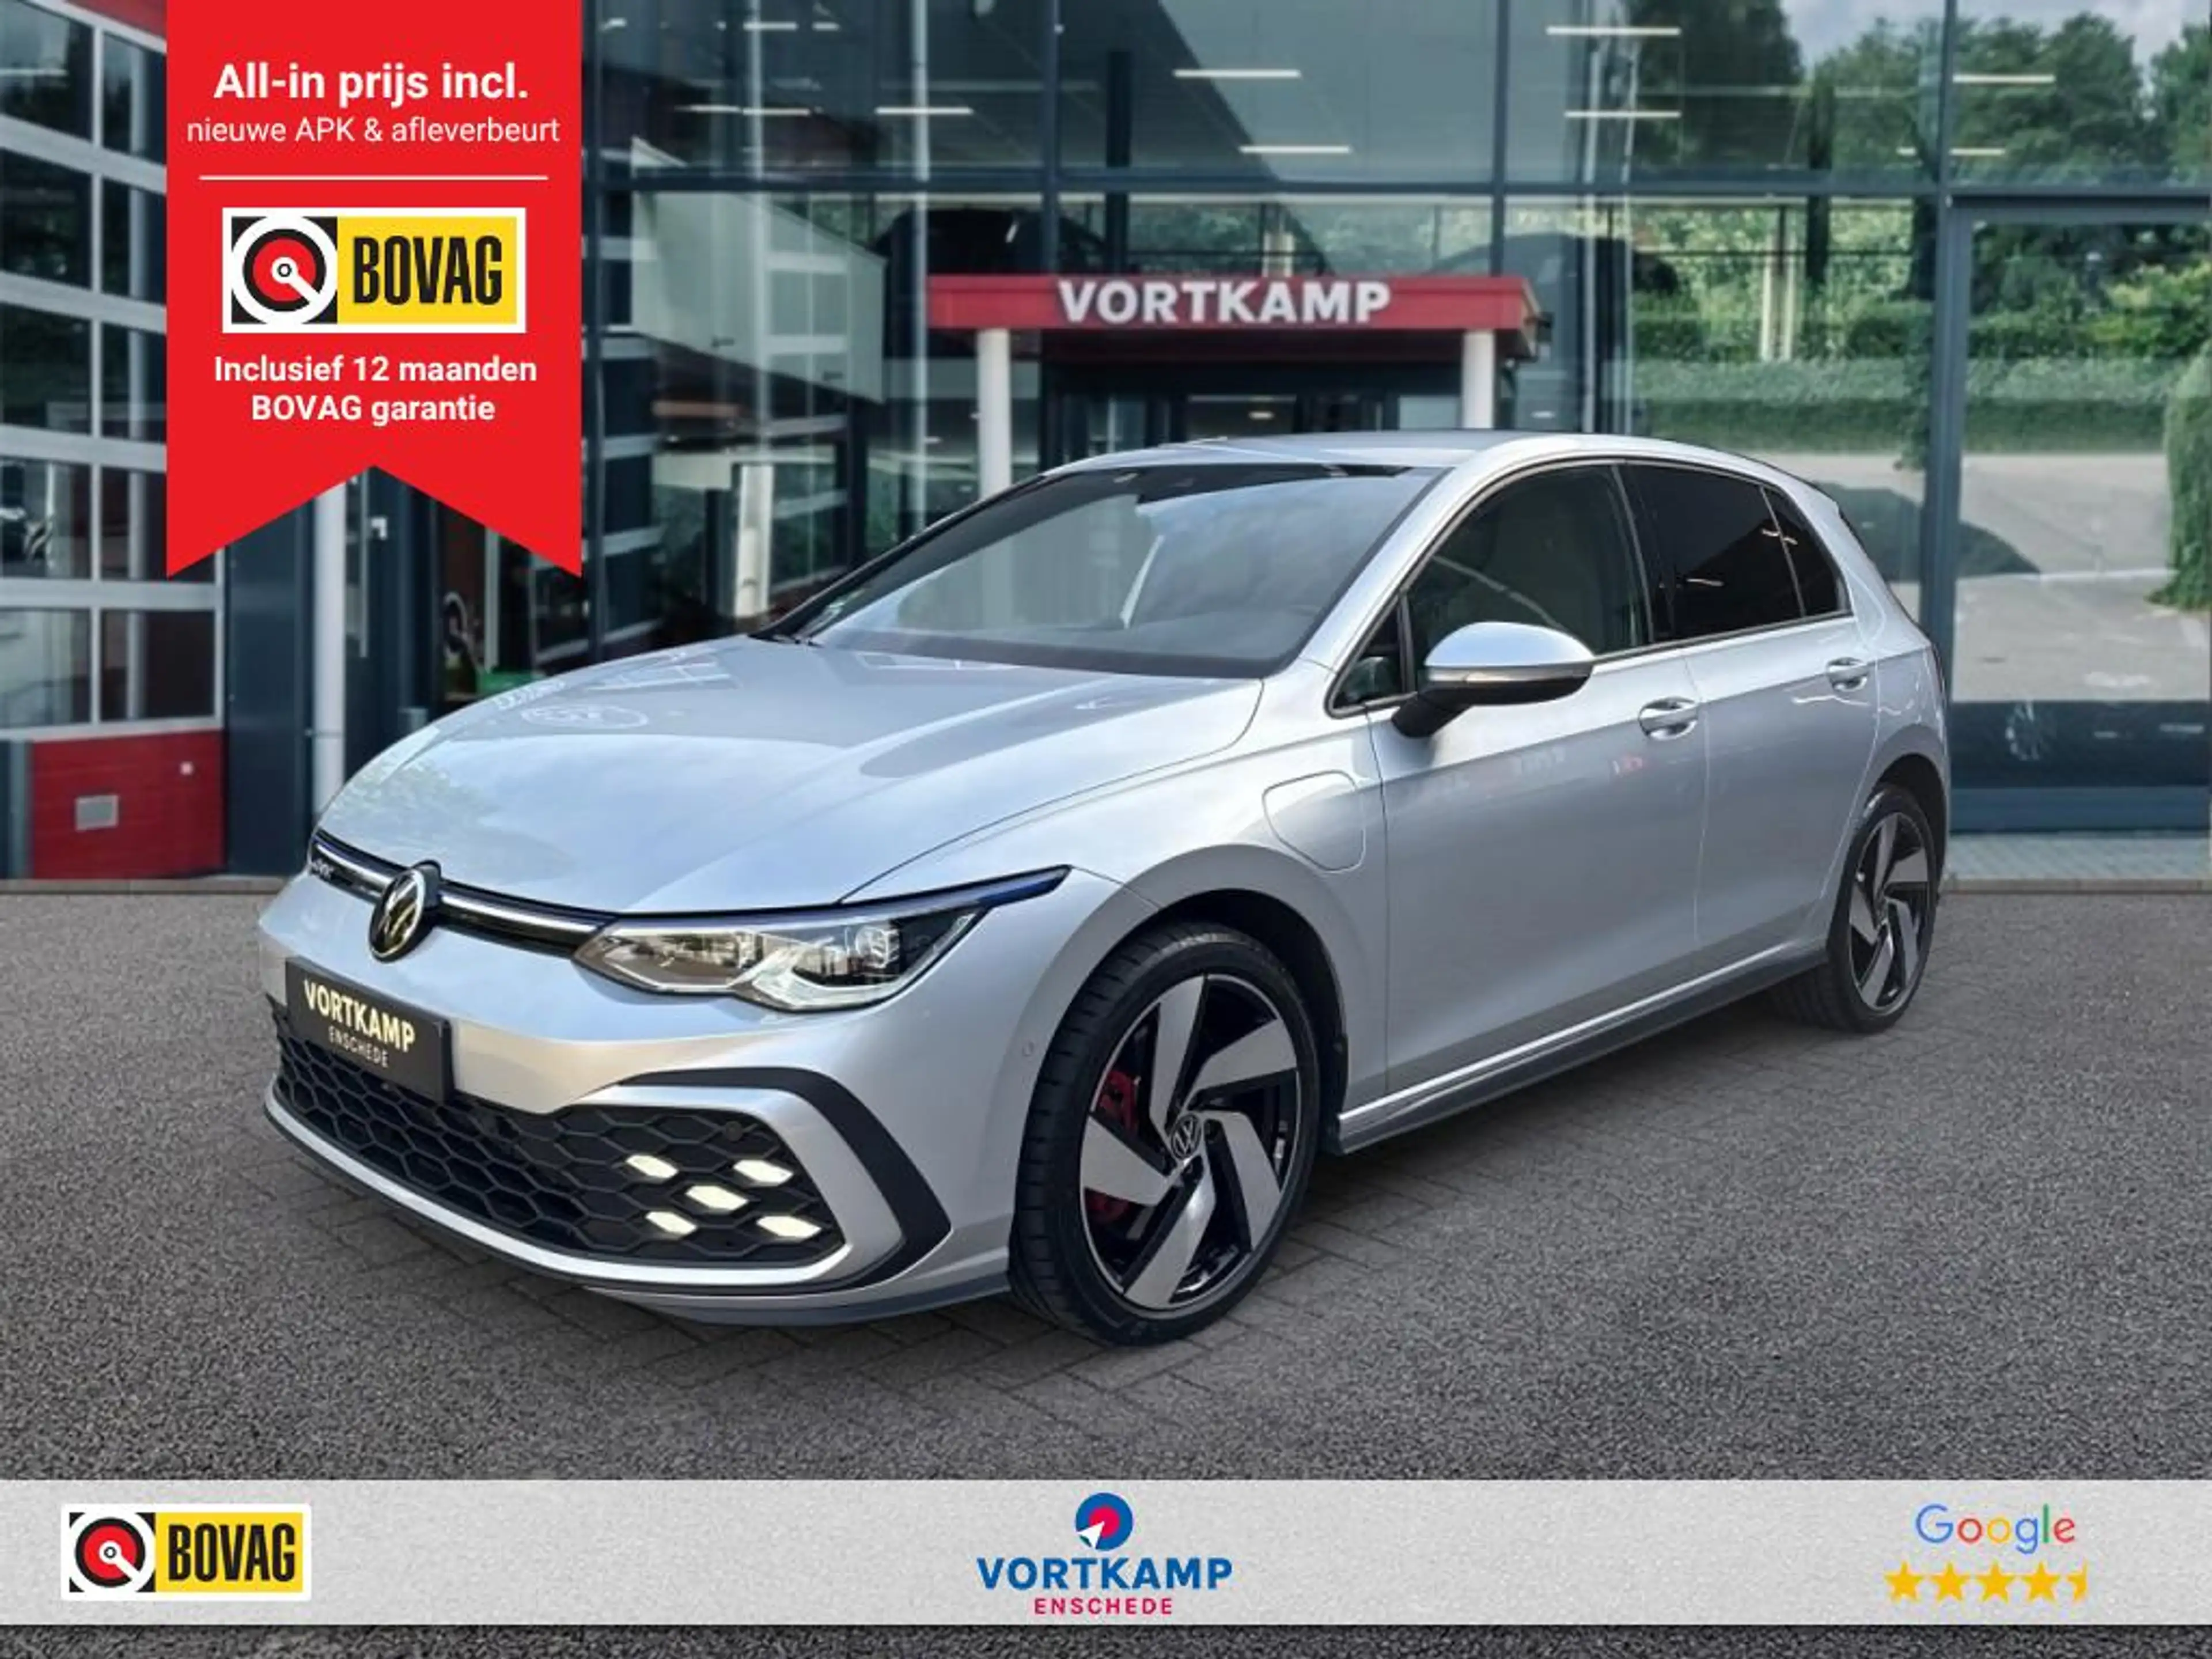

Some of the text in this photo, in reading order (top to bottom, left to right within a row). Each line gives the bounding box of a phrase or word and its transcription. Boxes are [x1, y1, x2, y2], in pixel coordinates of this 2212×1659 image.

[1059, 279, 1390, 323] VORTKAMP
[304, 978, 416, 1054] VORTKAMP
[328, 1025, 389, 1068] ENSCHEDE
